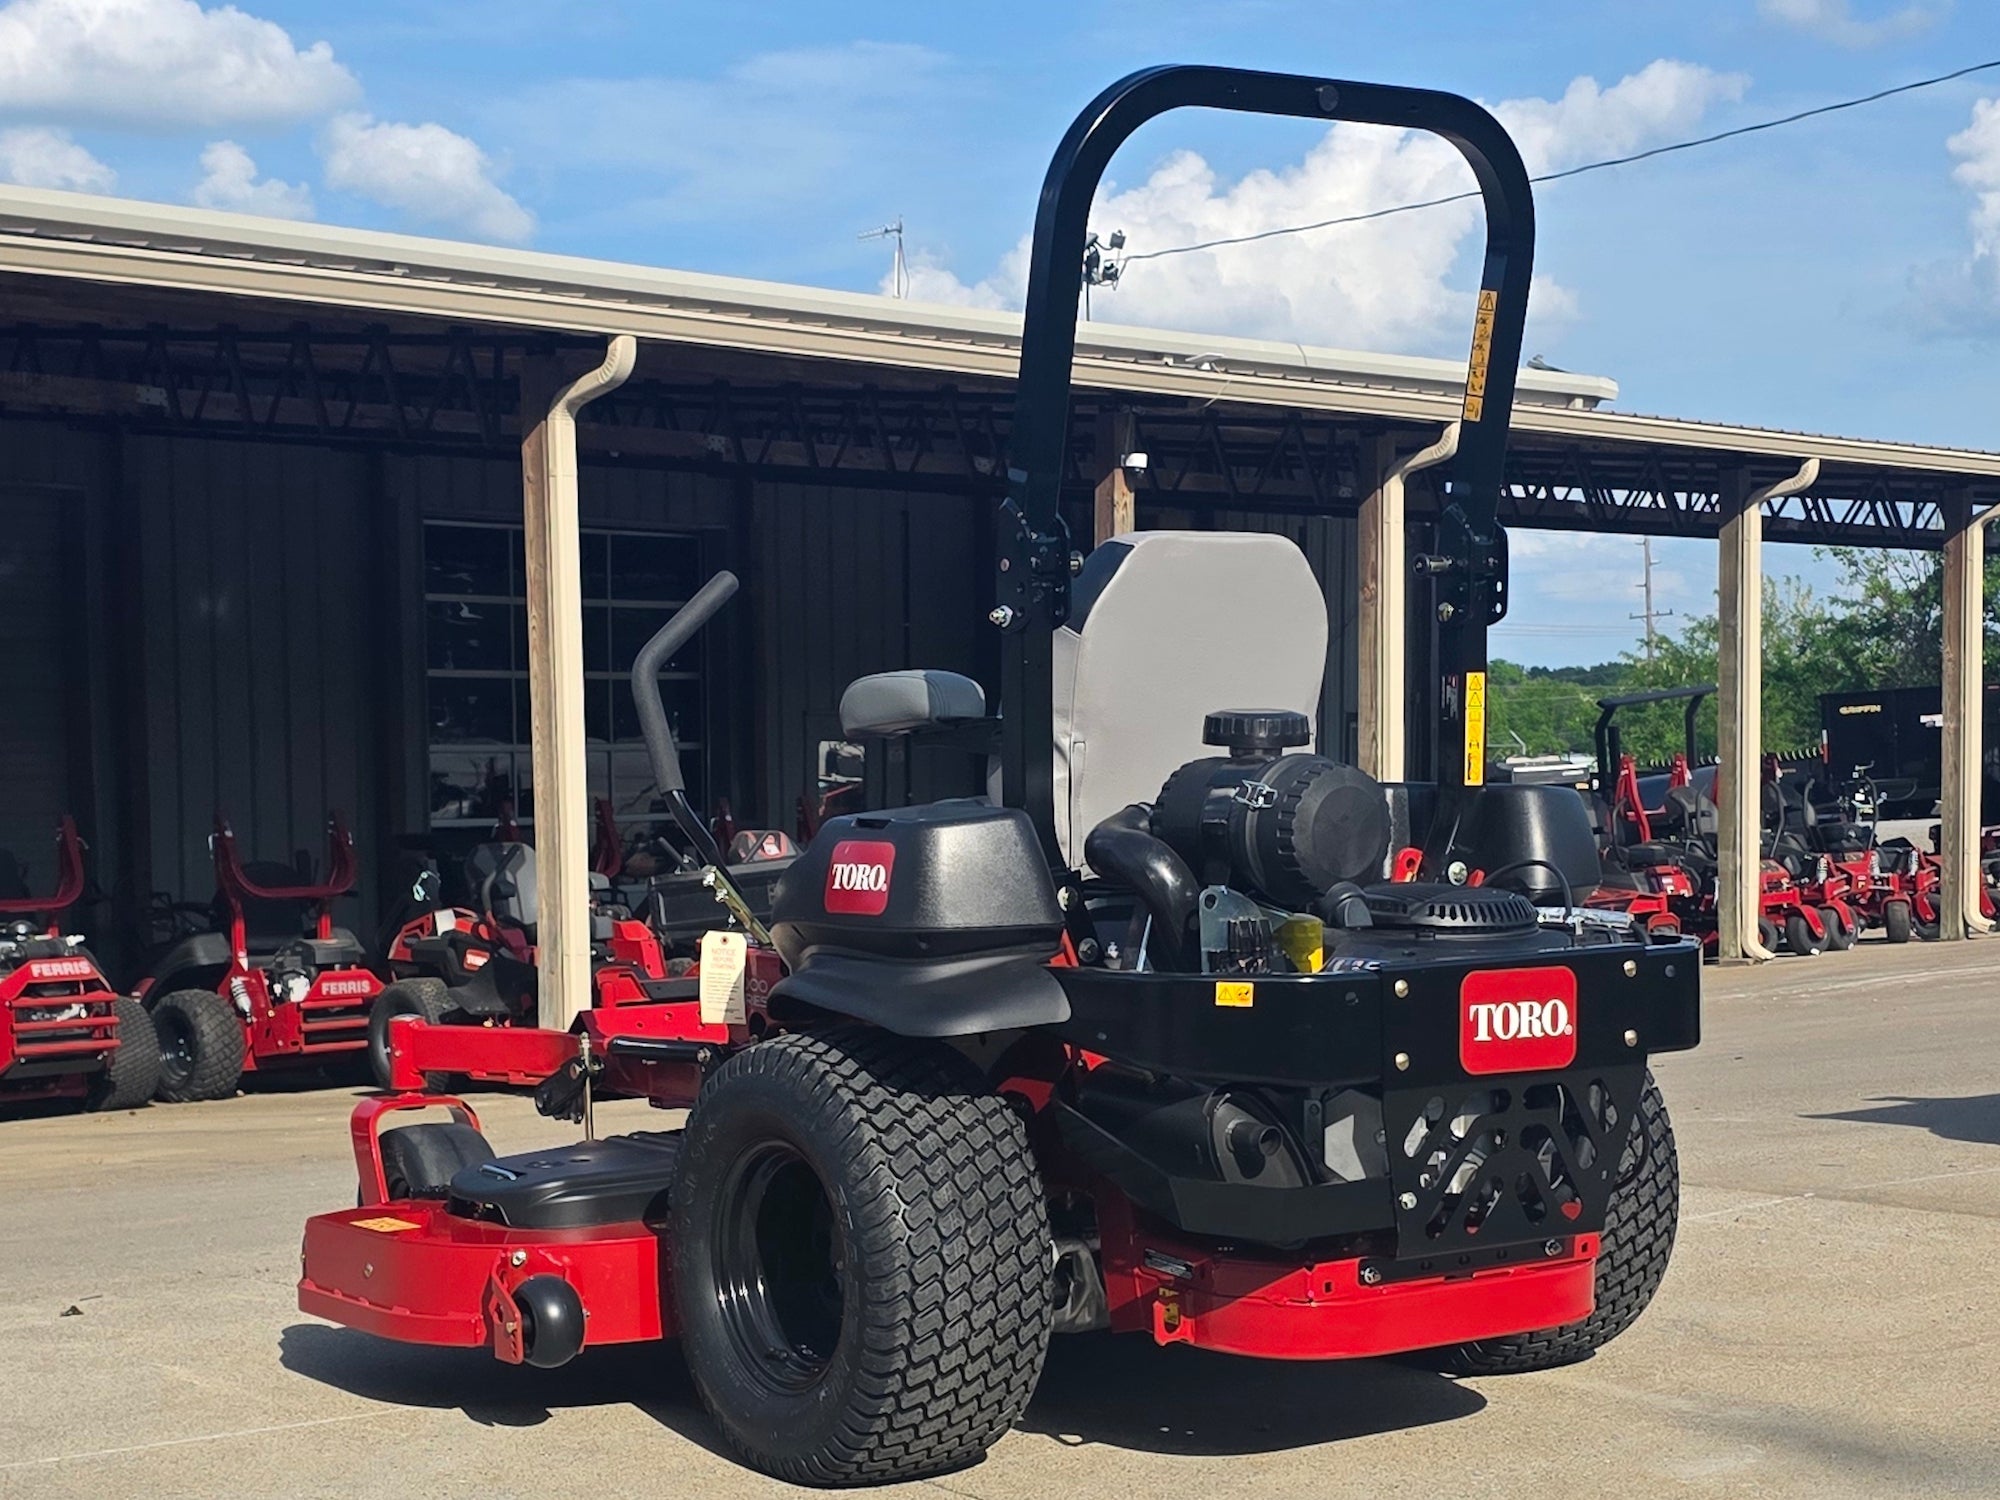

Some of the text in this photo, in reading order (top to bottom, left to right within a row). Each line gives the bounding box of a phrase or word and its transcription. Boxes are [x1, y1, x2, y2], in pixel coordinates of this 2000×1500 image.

[832, 863, 887, 892] TORO
[30, 960, 91, 978] FERRIS
[321, 979, 371, 996] FERRIS
[1469, 998, 1573, 1042] TORO
